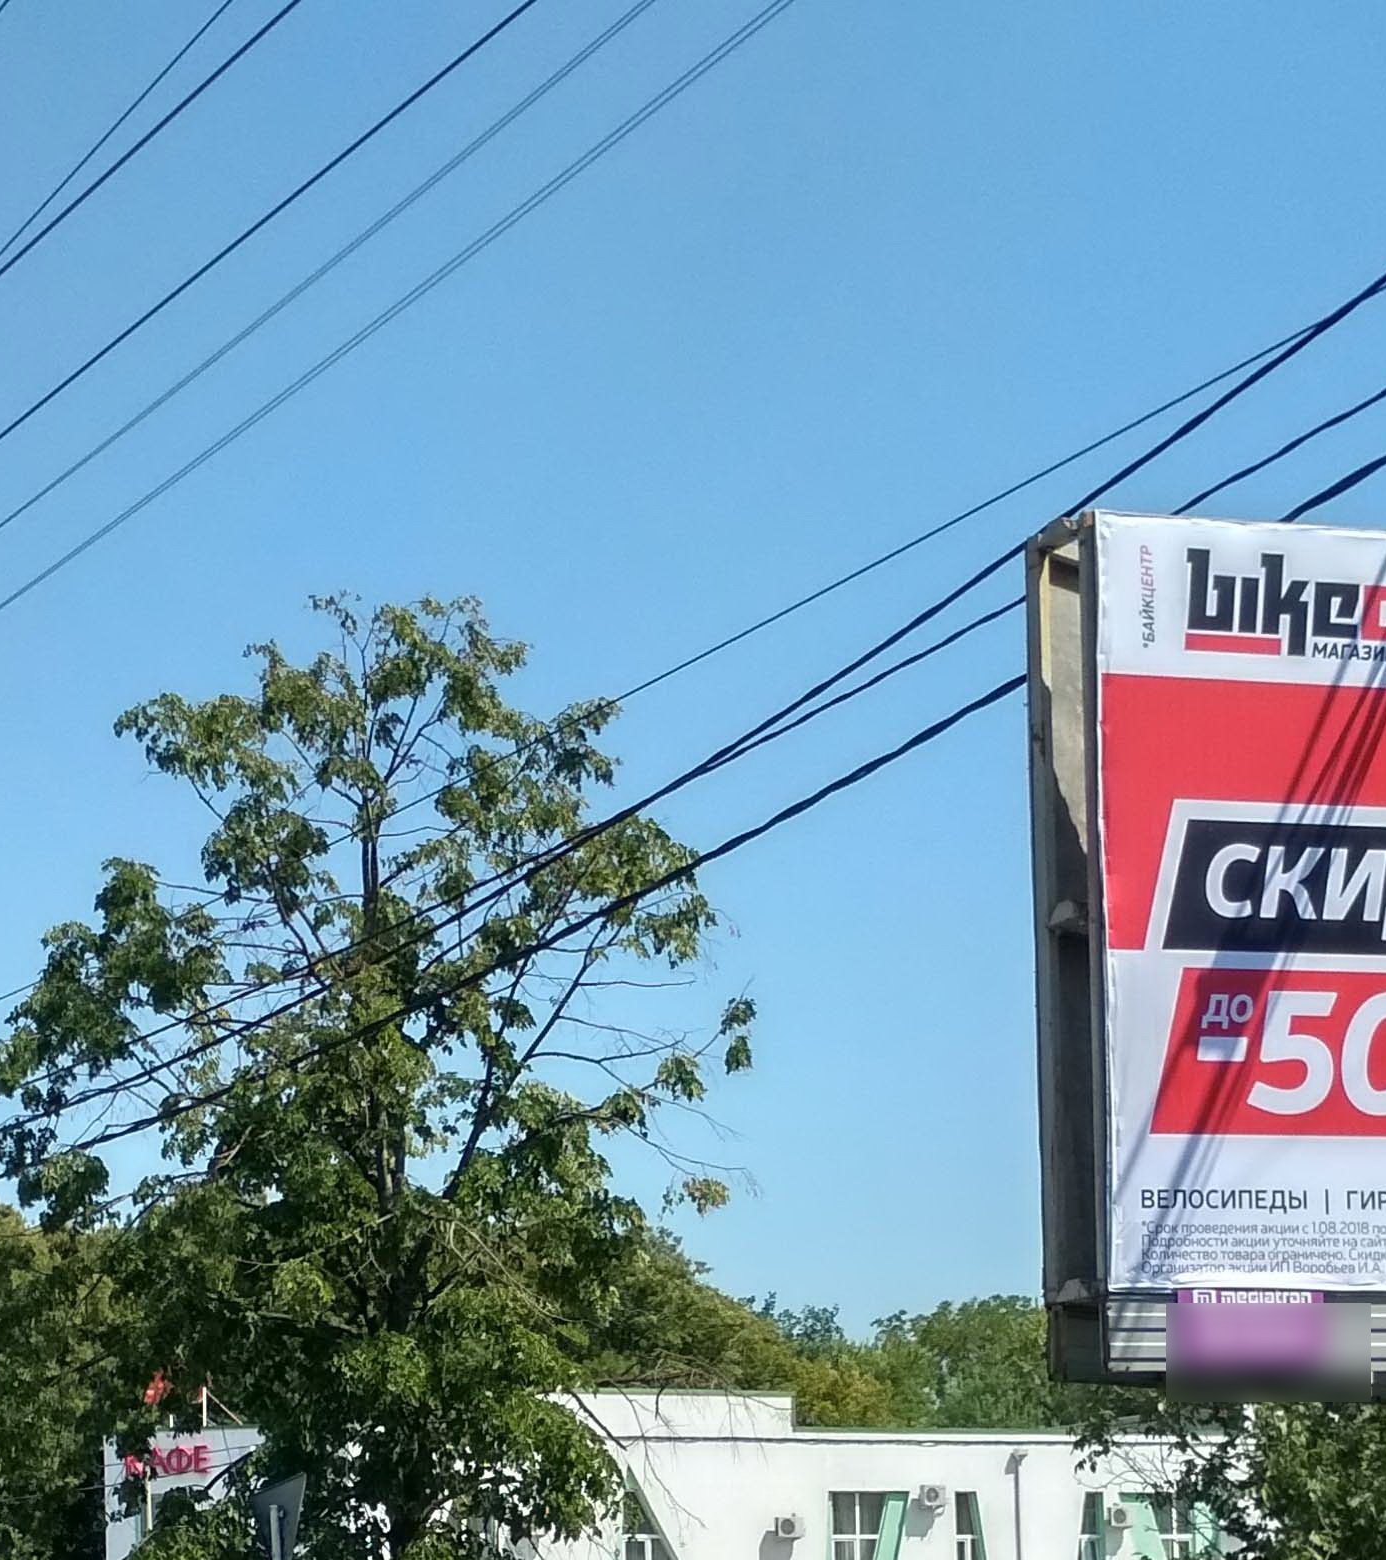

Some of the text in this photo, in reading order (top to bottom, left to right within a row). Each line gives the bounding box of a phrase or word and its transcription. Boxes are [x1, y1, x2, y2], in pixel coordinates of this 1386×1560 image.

[1140, 1188, 1309, 1214] ВЕЛОСИПЕДЫ
[1181, 1223, 1258, 1236] проведения
[1260, 1224, 1300, 1236] акции
[1141, 1234, 1229, 1249] Подробности
[1230, 1237, 1271, 1249] акции
[1273, 1235, 1341, 1249] уточняйте
[1342, 1237, 1359, 1248] на
[1141, 1249, 1219, 1261] Количество
[1221, 1251, 1266, 1263] товара
